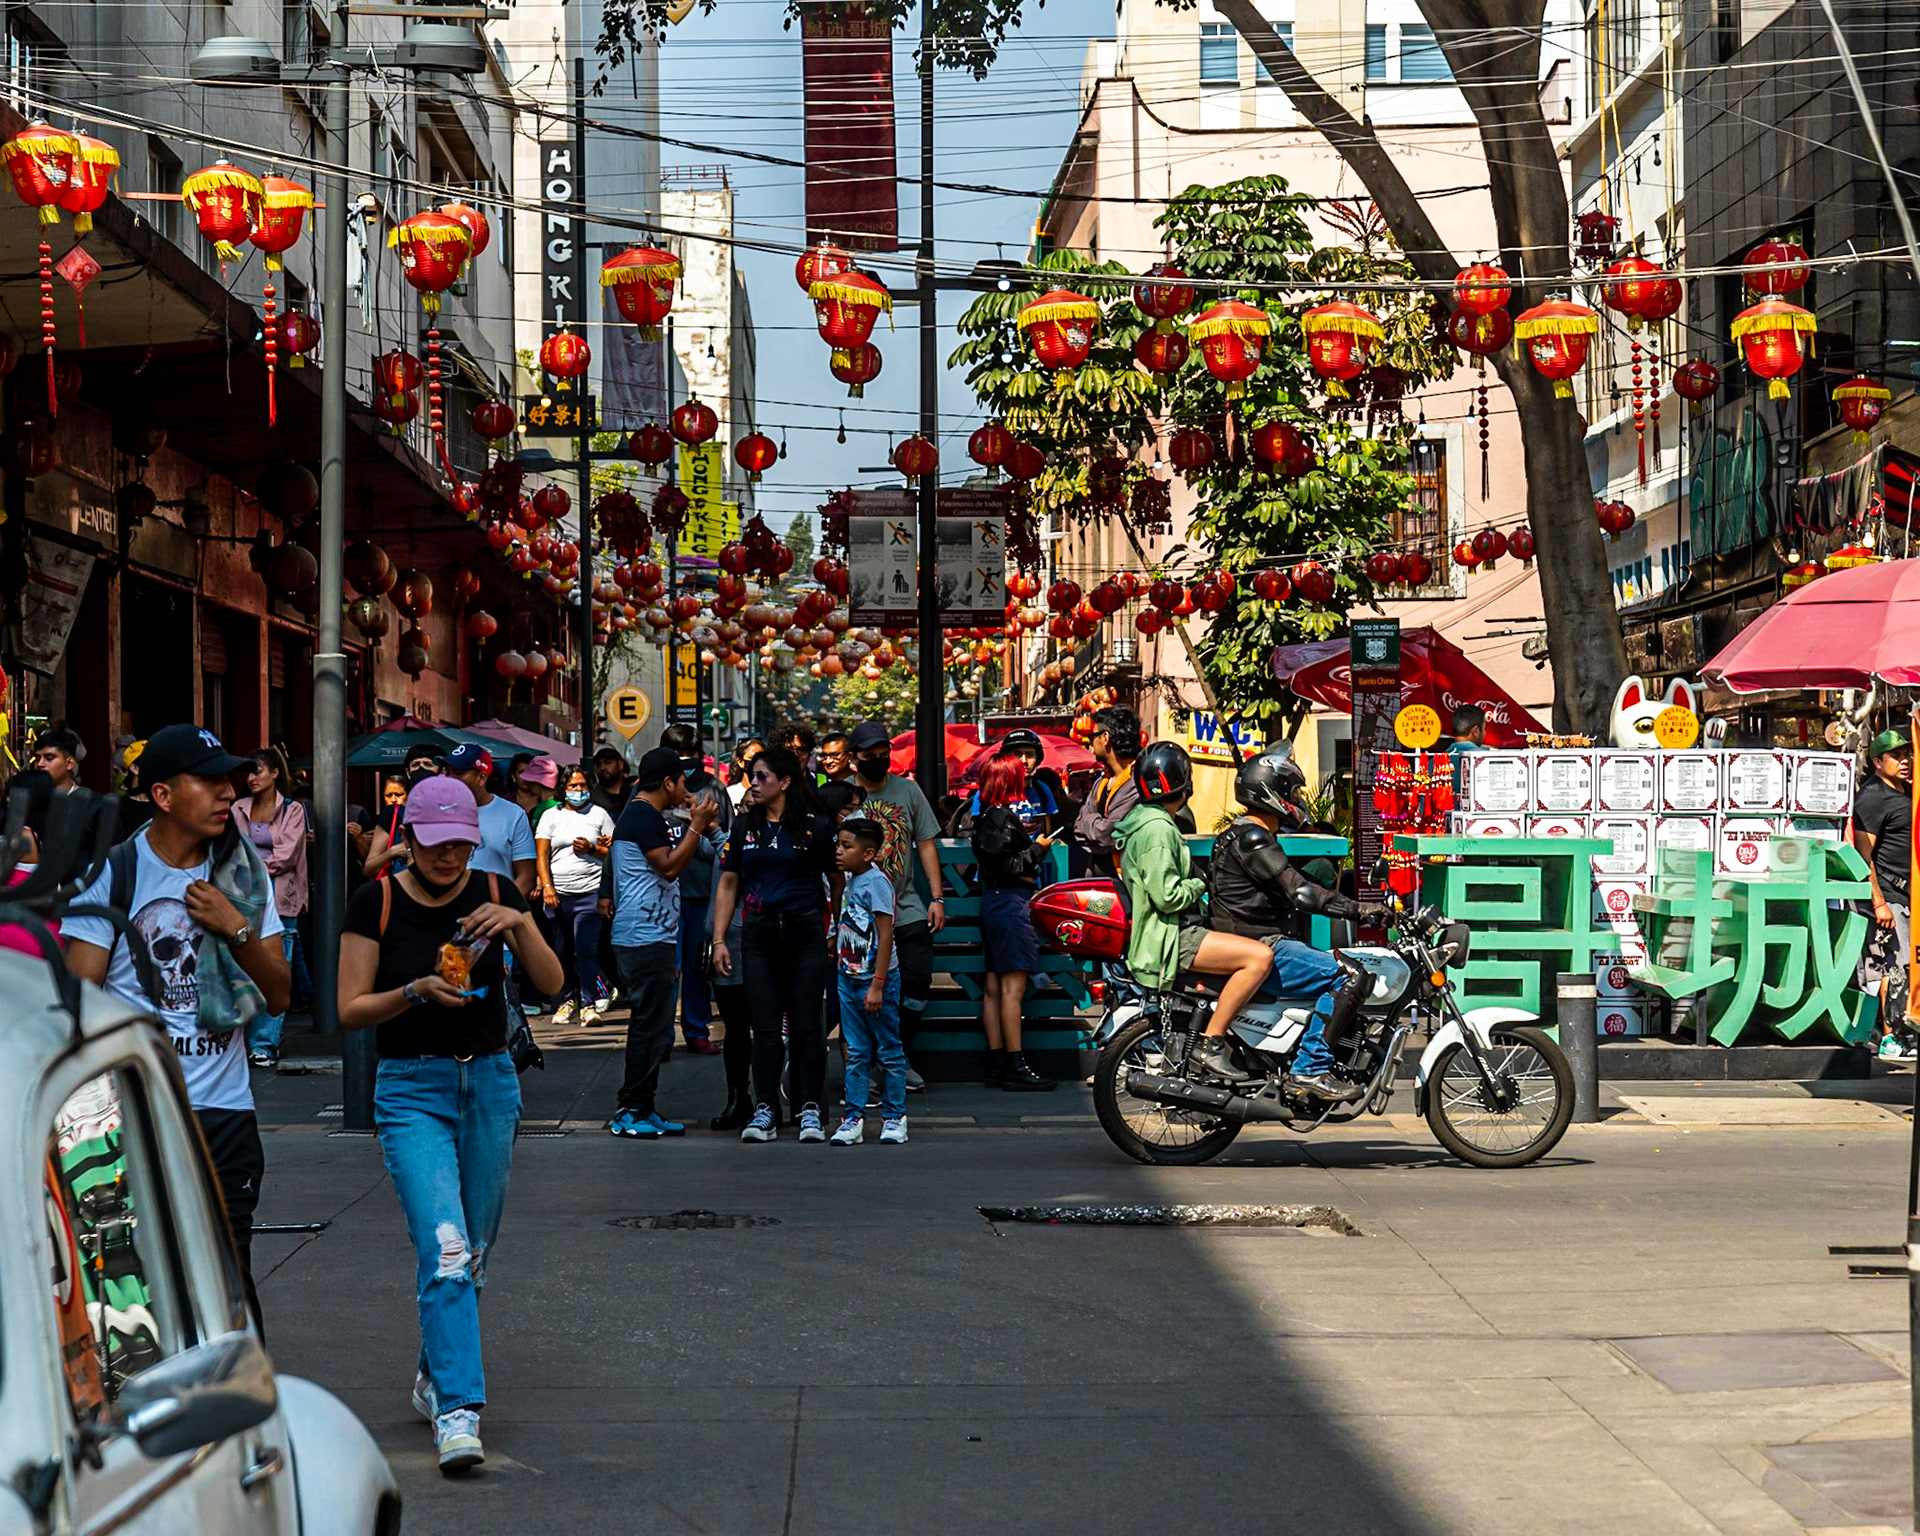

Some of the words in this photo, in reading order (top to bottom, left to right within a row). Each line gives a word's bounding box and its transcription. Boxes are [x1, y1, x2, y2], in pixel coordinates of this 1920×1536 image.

[546, 149, 573, 263] HONG
[855, 220, 894, 232] CHINO
[691, 454, 710, 495] HONG
[691, 512, 711, 553] KING
[1358, 677, 1377, 686] Barrio
[1377, 676, 1396, 686] Chino
[619, 696, 637, 720] E
[1664, 708, 1690, 718] PULSERA
[1191, 745, 1205, 753] AL
[1738, 846, 1756, 863] 福
[1610, 892, 1627, 908] 福
[1233, 1015, 1274, 1030] ITALIKA
[1606, 1015, 1624, 1033] 福
